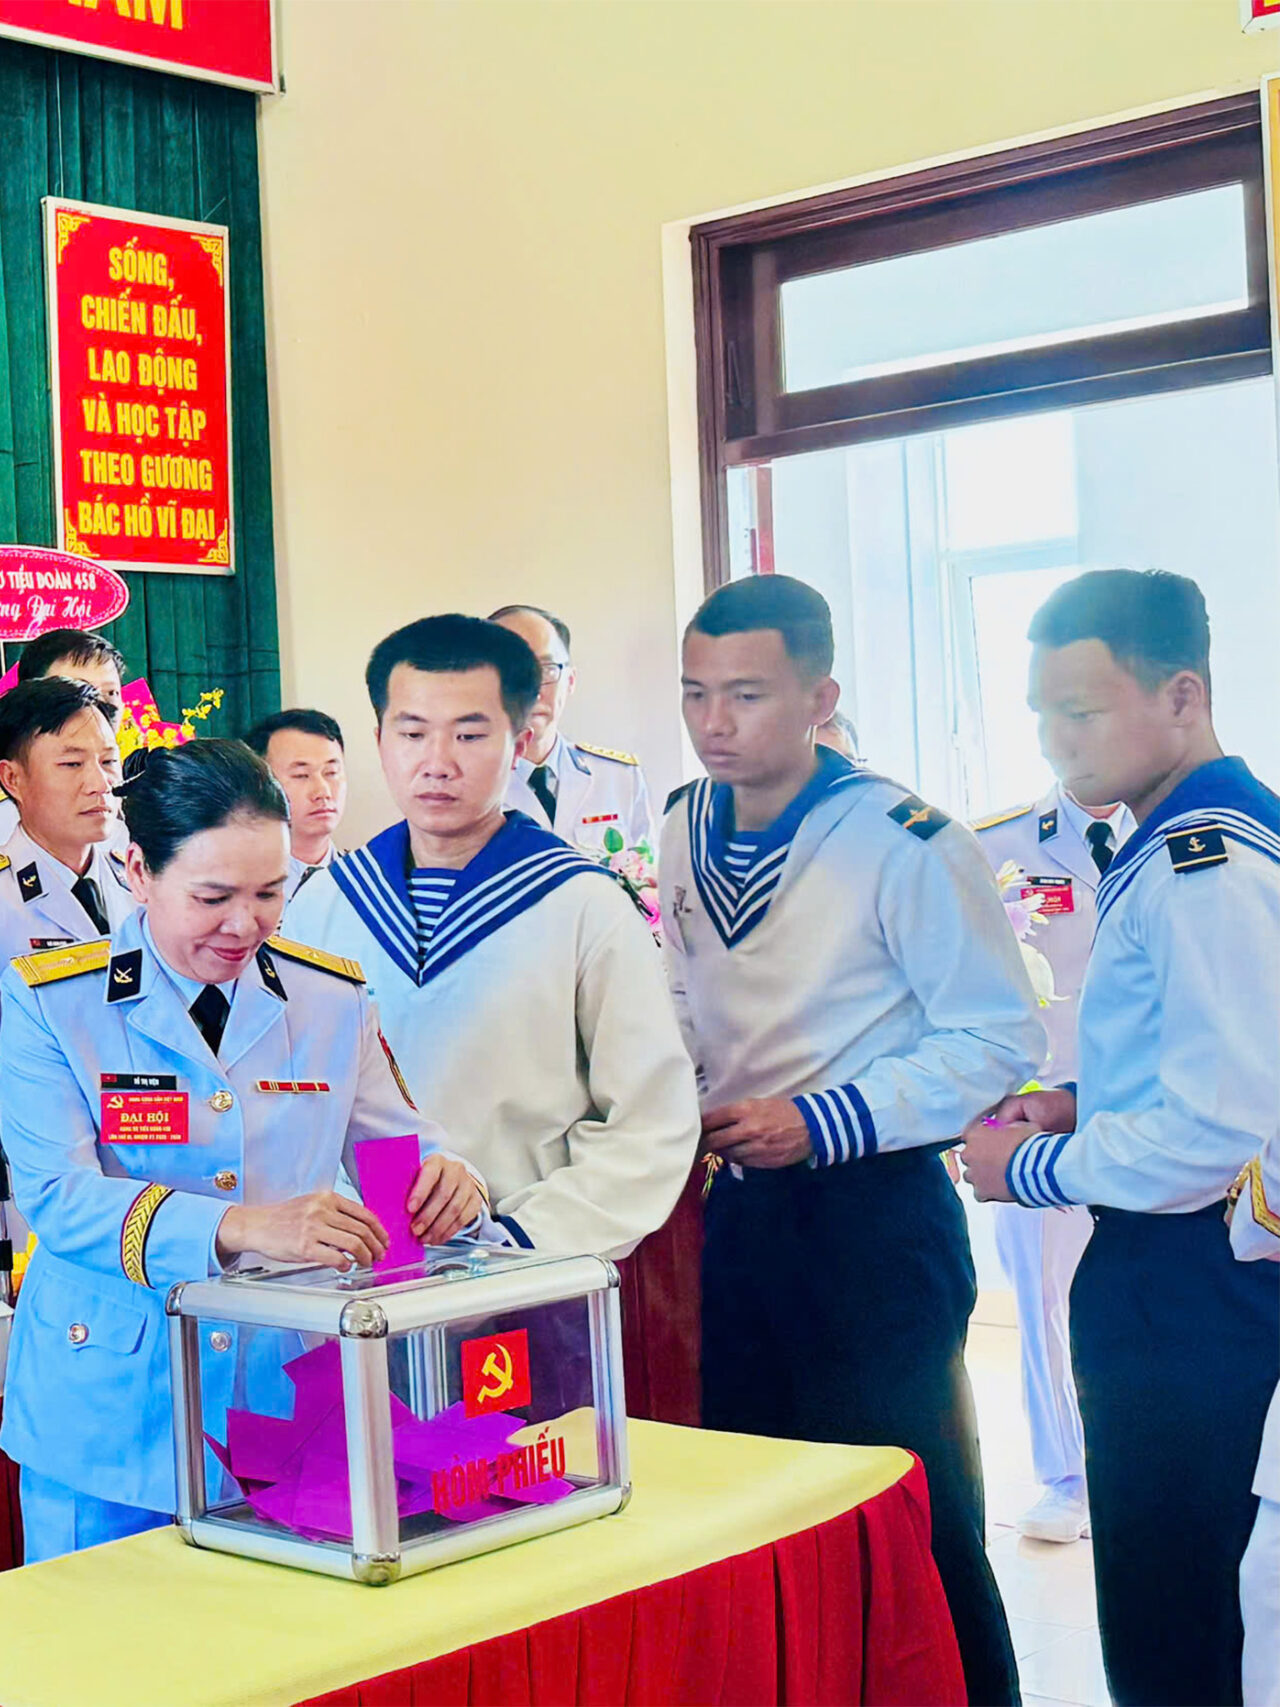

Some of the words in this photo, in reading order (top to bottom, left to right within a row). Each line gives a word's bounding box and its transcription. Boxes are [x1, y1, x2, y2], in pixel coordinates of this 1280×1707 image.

[108, 236, 175, 291] SỐNG,
[81, 287, 147, 336] CHIẾN
[152, 294, 203, 346] ĐẤU,
[87, 347, 130, 384] LAO
[138, 347, 198, 395] ĐỘNG
[81, 392, 112, 433] VÀ
[116, 402, 160, 444] HỌC
[164, 400, 207, 447] TẬP
[79, 449, 135, 486] THEO
[140, 453, 213, 491] GƯƠNG
[77, 494, 120, 536] BÁC
[124, 492, 153, 537] HỒ
[156, 500, 178, 538] VĨ
[181, 507, 216, 547] ĐẠI
[73, 571, 97, 591] 458
[495, 1425, 566, 1495] PHIẾU
